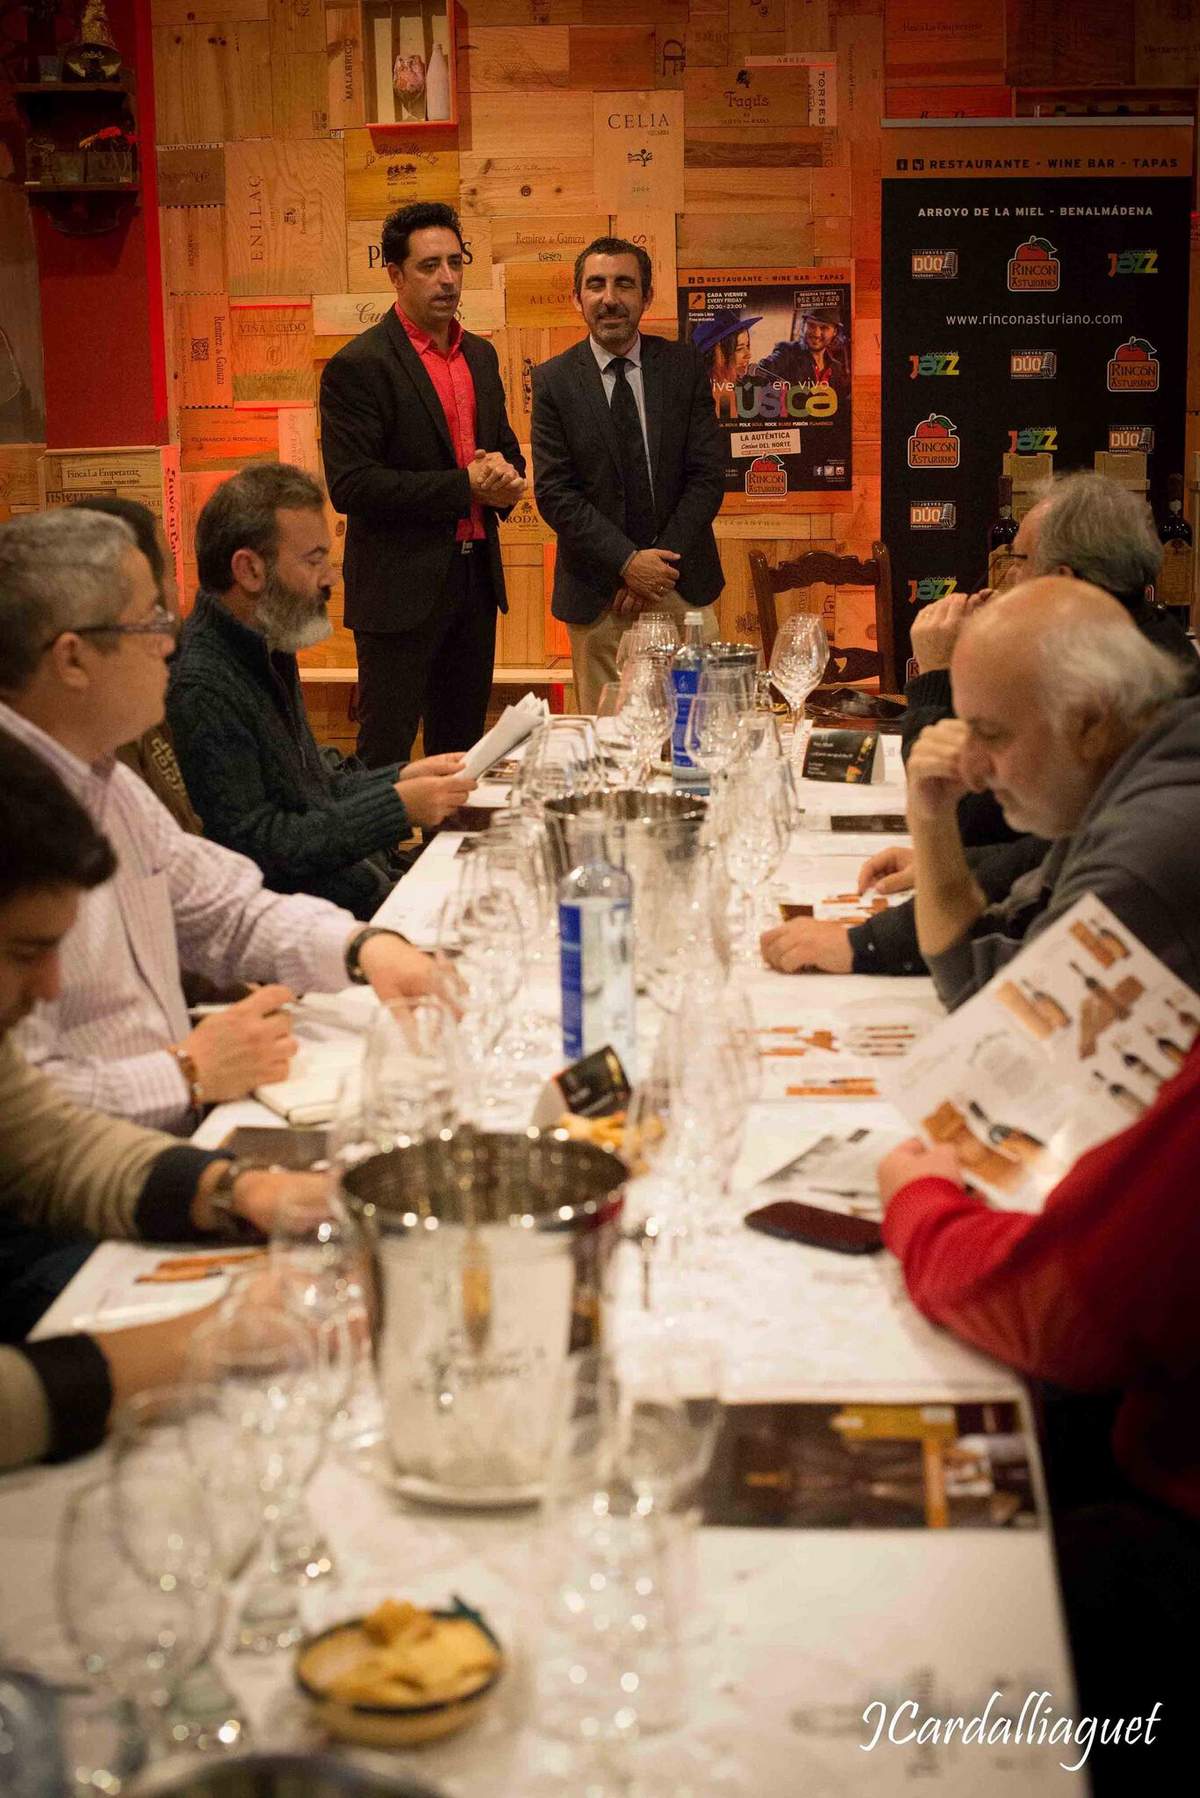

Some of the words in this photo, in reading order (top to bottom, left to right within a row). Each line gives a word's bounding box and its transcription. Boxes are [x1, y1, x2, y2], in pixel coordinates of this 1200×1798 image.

[818, 71, 827, 126] TORRES
[608, 113, 670, 129] CELIA
[930, 160, 1030, 169] RESTAURANTE
[1048, 159, 1080, 168] WINE
[1087, 159, 1115, 168] BAR
[1132, 159, 1178, 168] TAPAS
[917, 207, 970, 217] ARROYO
[974, 207, 990, 216] DE
[995, 207, 1010, 216] LA
[1015, 207, 1045, 216] MIEL
[1060, 204, 1154, 216] BENALMÁDENA
[707, 276, 763, 284] RESTAURANTE
[773, 275, 792, 283] WINE
[820, 273, 845, 281] TAPAS
[945, 312, 1123, 326] www.rinconasturiano.com
[1013, 356, 1041, 372] DÚO
[772, 380, 792, 391] en
[797, 377, 830, 390] vivo
[740, 434, 750, 443] LA
[751, 431, 790, 441] AUTÉNTICA
[771, 440, 792, 448] NORTE
[1111, 431, 1141, 447] DÚO
[507, 515, 539, 524] RODA
[912, 507, 942, 525] DÚO
